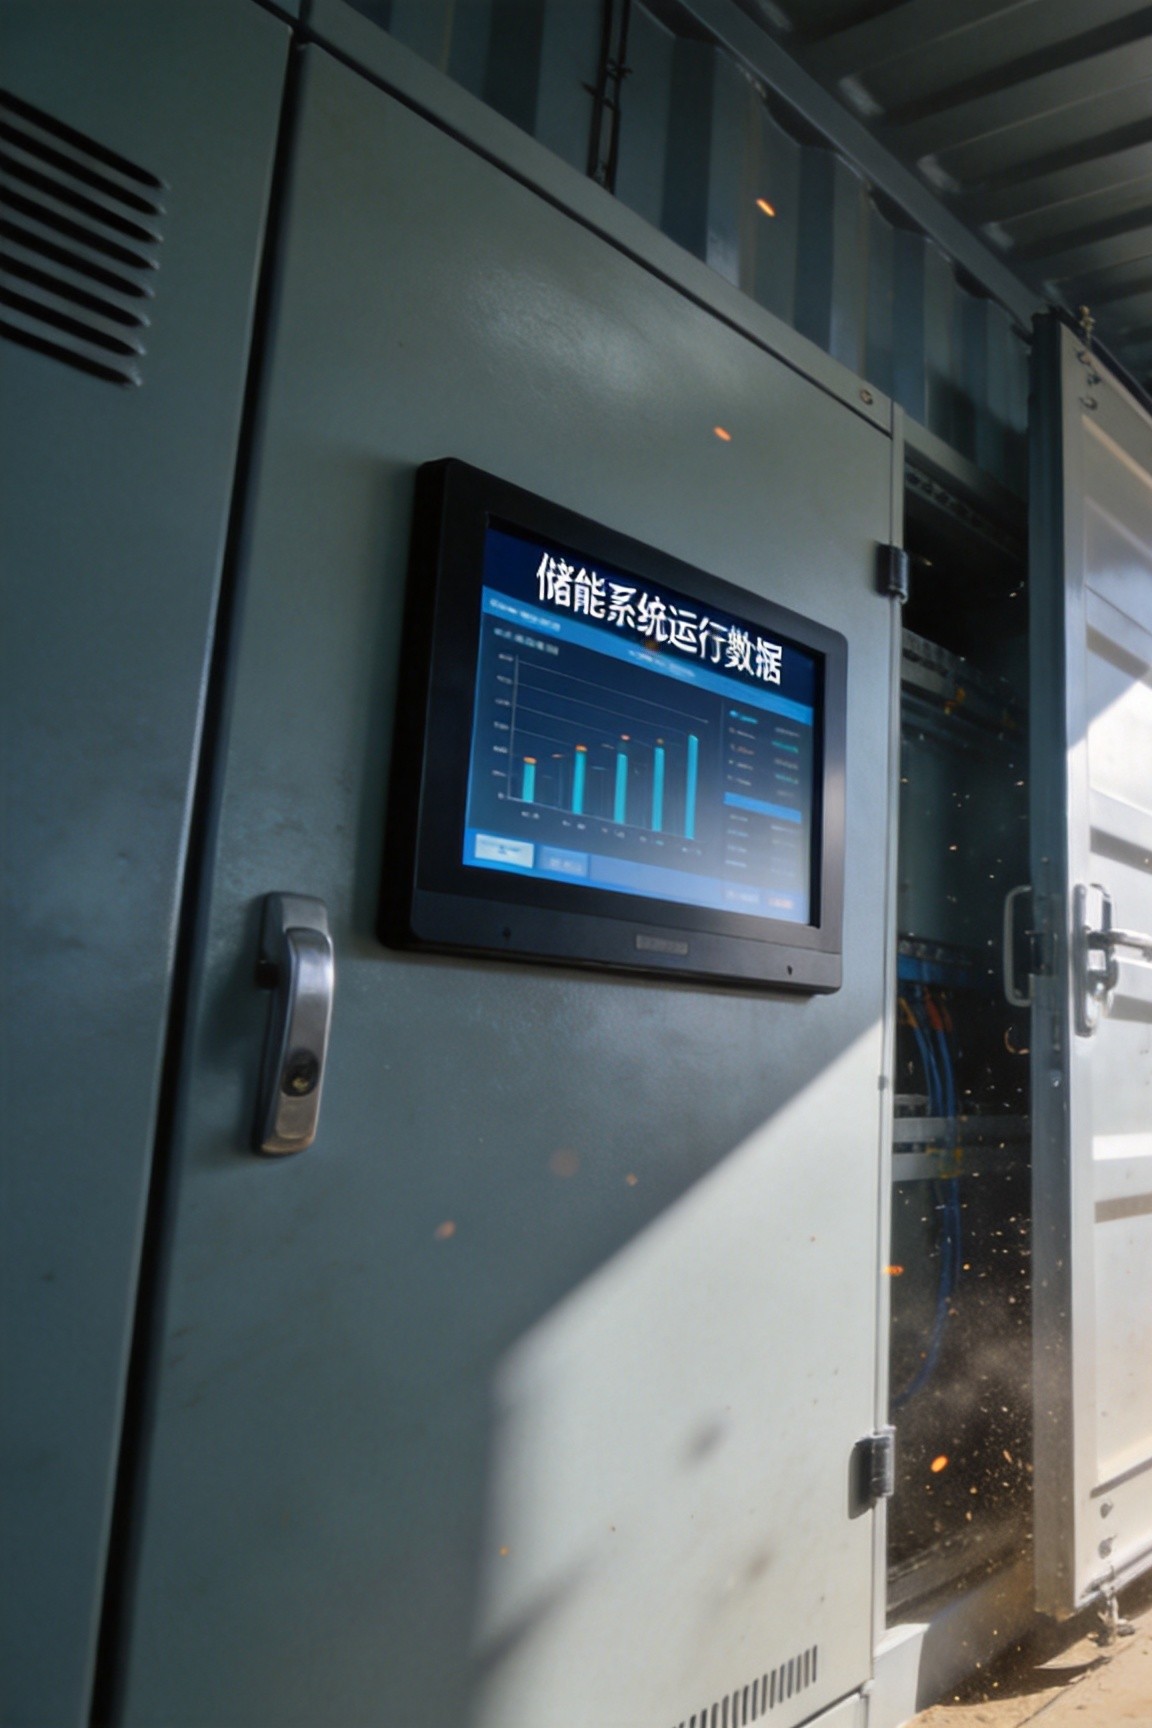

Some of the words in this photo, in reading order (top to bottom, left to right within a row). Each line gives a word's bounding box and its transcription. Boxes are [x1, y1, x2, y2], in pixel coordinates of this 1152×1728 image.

[536, 552, 783, 686] 储能系统运行数据
